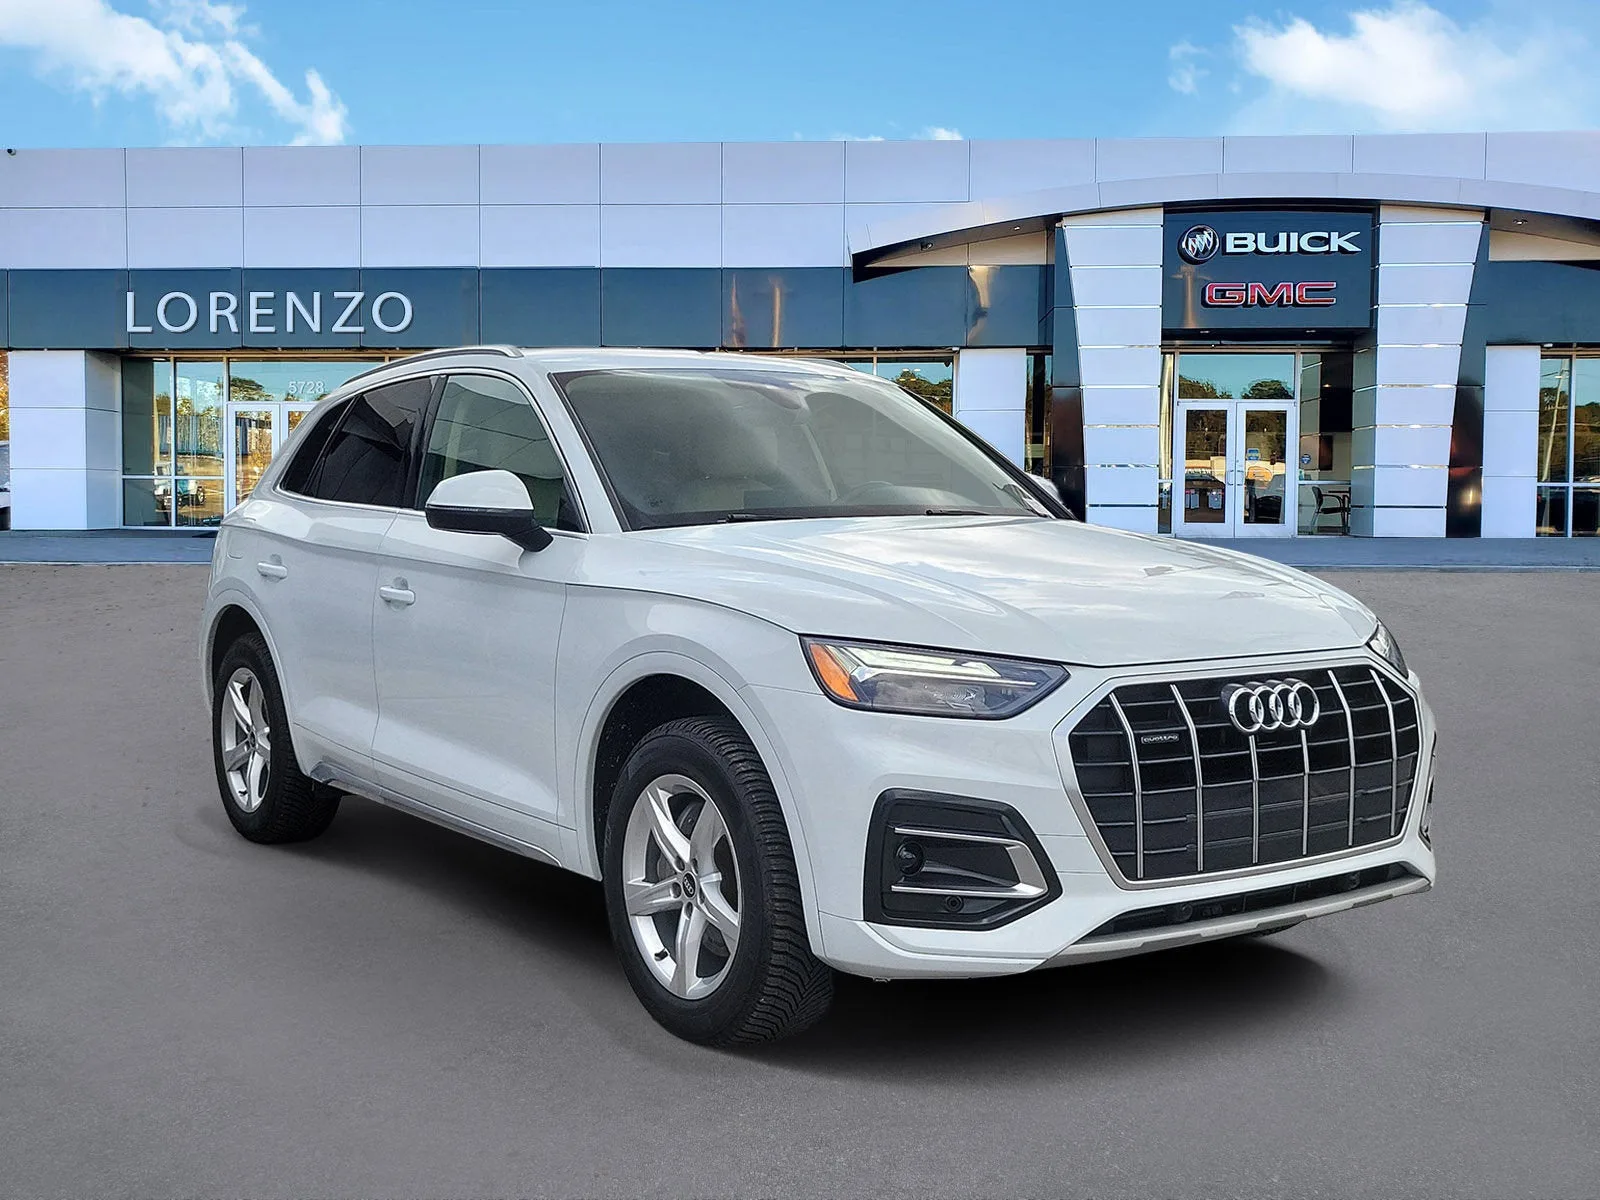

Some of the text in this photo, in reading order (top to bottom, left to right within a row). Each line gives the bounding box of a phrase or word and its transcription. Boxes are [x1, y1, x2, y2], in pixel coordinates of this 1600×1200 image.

[1225, 231, 1362, 252] BUICK
[1205, 282, 1337, 305] GMC
[126, 291, 414, 333] LORENZO
[289, 381, 324, 394] 5728
